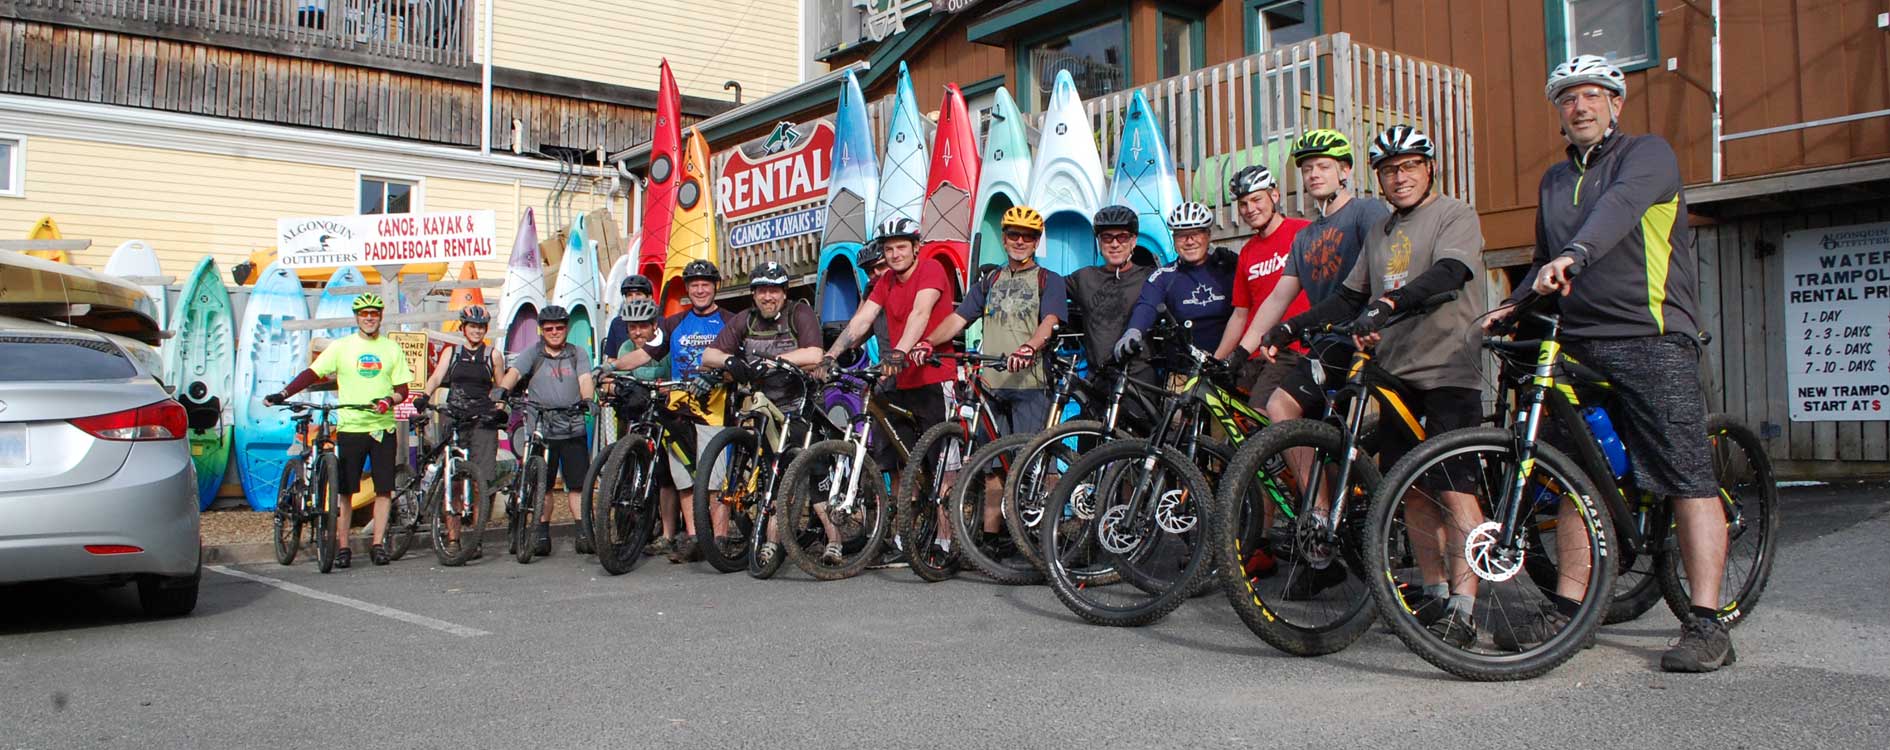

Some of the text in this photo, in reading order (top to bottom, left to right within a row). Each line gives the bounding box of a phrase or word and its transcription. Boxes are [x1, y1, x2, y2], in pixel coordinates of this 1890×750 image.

[717, 149, 833, 216] RENTAL
[282, 219, 356, 243] ALGONQUIN
[377, 214, 475, 237] CANOE, KAYAK &
[736, 222, 770, 245] CANOES
[776, 213, 810, 236] KAYAKS
[364, 236, 492, 261] PADDLEBOAT RENTALS
[282, 252, 358, 265] OUTFITTERS
[1790, 287, 1858, 304] RENTAL
[1819, 310, 1842, 322] DAY
[1804, 328, 1812, 340] 2
[1823, 328, 1832, 339] 3
[1844, 325, 1872, 338] DAYS
[1805, 345, 1813, 357] 4
[1824, 344, 1832, 356] 6
[1844, 342, 1873, 355] DAYS
[1805, 362, 1814, 374] 7
[1823, 361, 1837, 373] 10
[1848, 360, 1877, 372] DAYS
[1798, 384, 1889, 398] NEW TRAMPO
[1804, 400, 1847, 412] START
[1852, 399, 1870, 411] AT
[1581, 495, 1608, 557] MAXXIS
